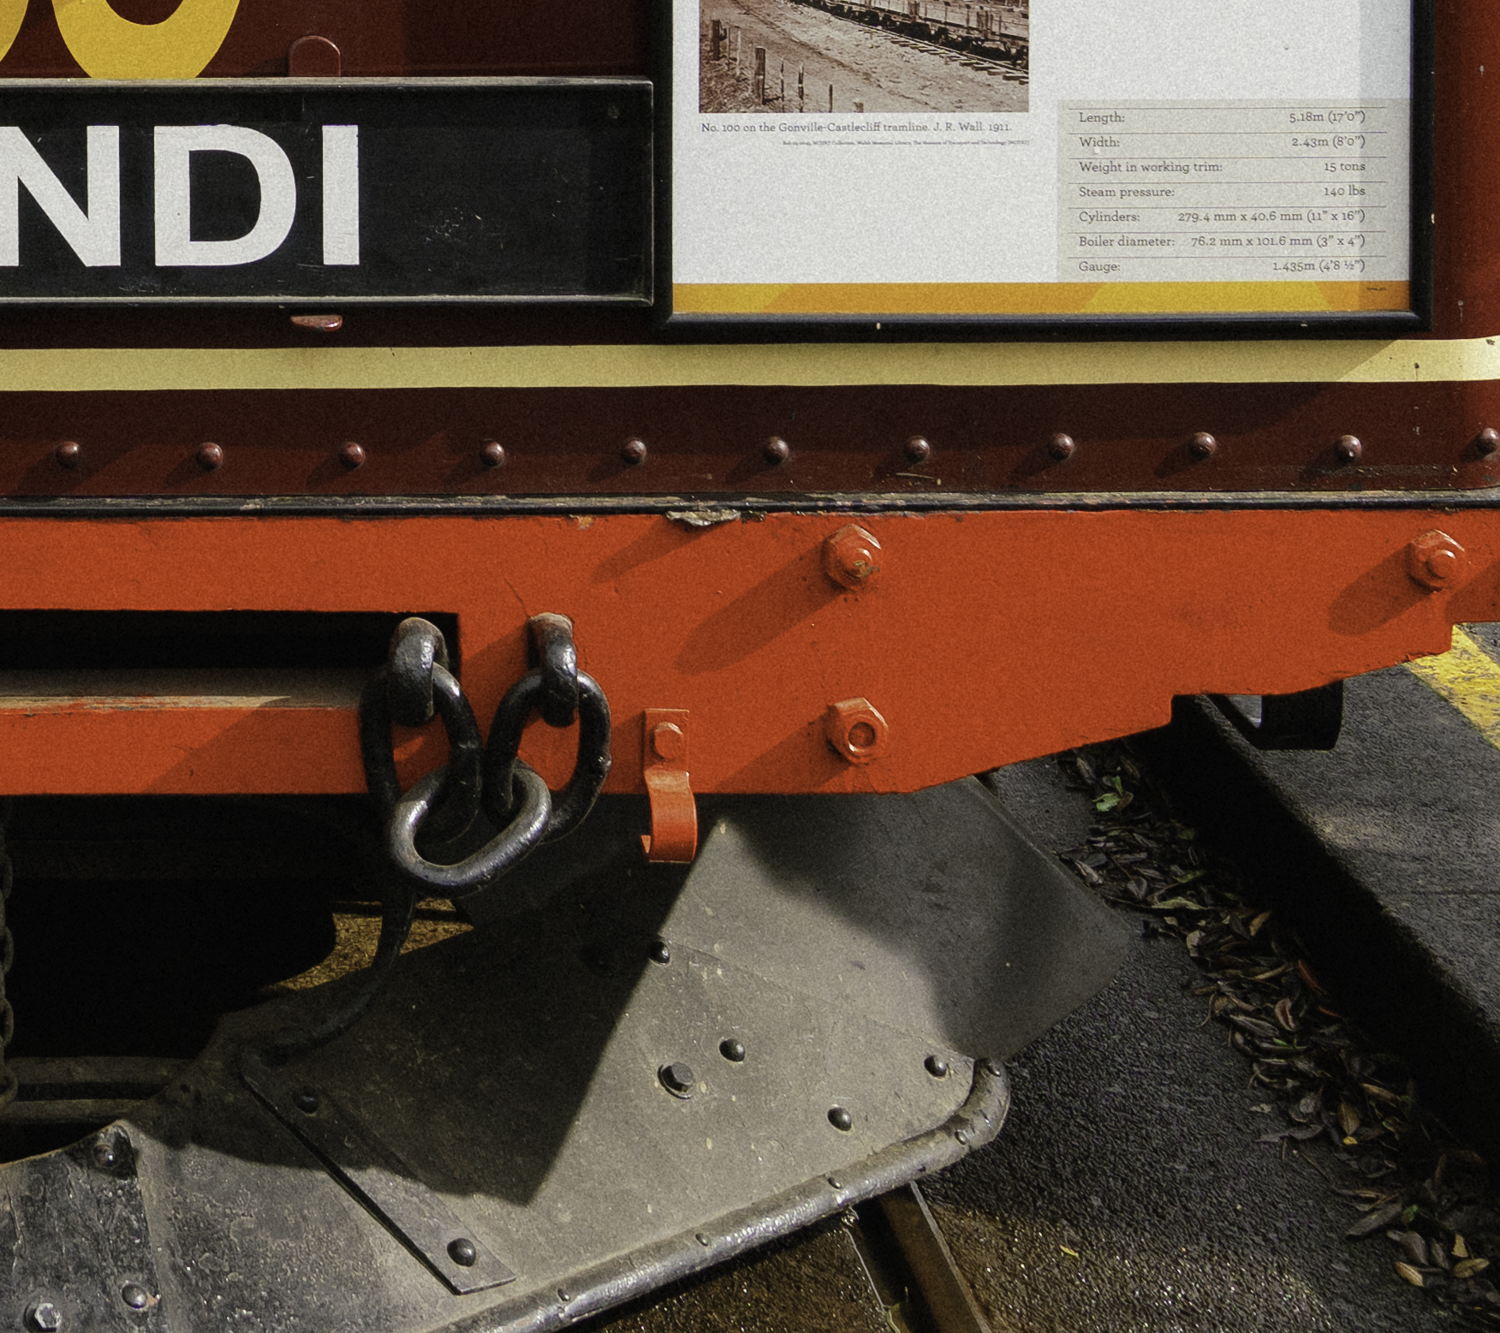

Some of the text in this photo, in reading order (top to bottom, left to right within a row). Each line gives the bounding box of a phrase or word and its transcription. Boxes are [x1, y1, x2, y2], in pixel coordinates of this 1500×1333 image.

[1079, 112, 1126, 125] Length:
[1289, 111, 1325, 123] 5.18m
[701, 122, 719, 133] No.
[722, 124, 741, 132] 100
[759, 122, 776, 132] the
[778, 121, 881, 132] Gonville-Castlecliff
[1079, 136, 1120, 148] Width:
[1291, 137, 1329, 148] 2.43m
[1079, 161, 1366, 174] Weight in working trim: 15 tons
